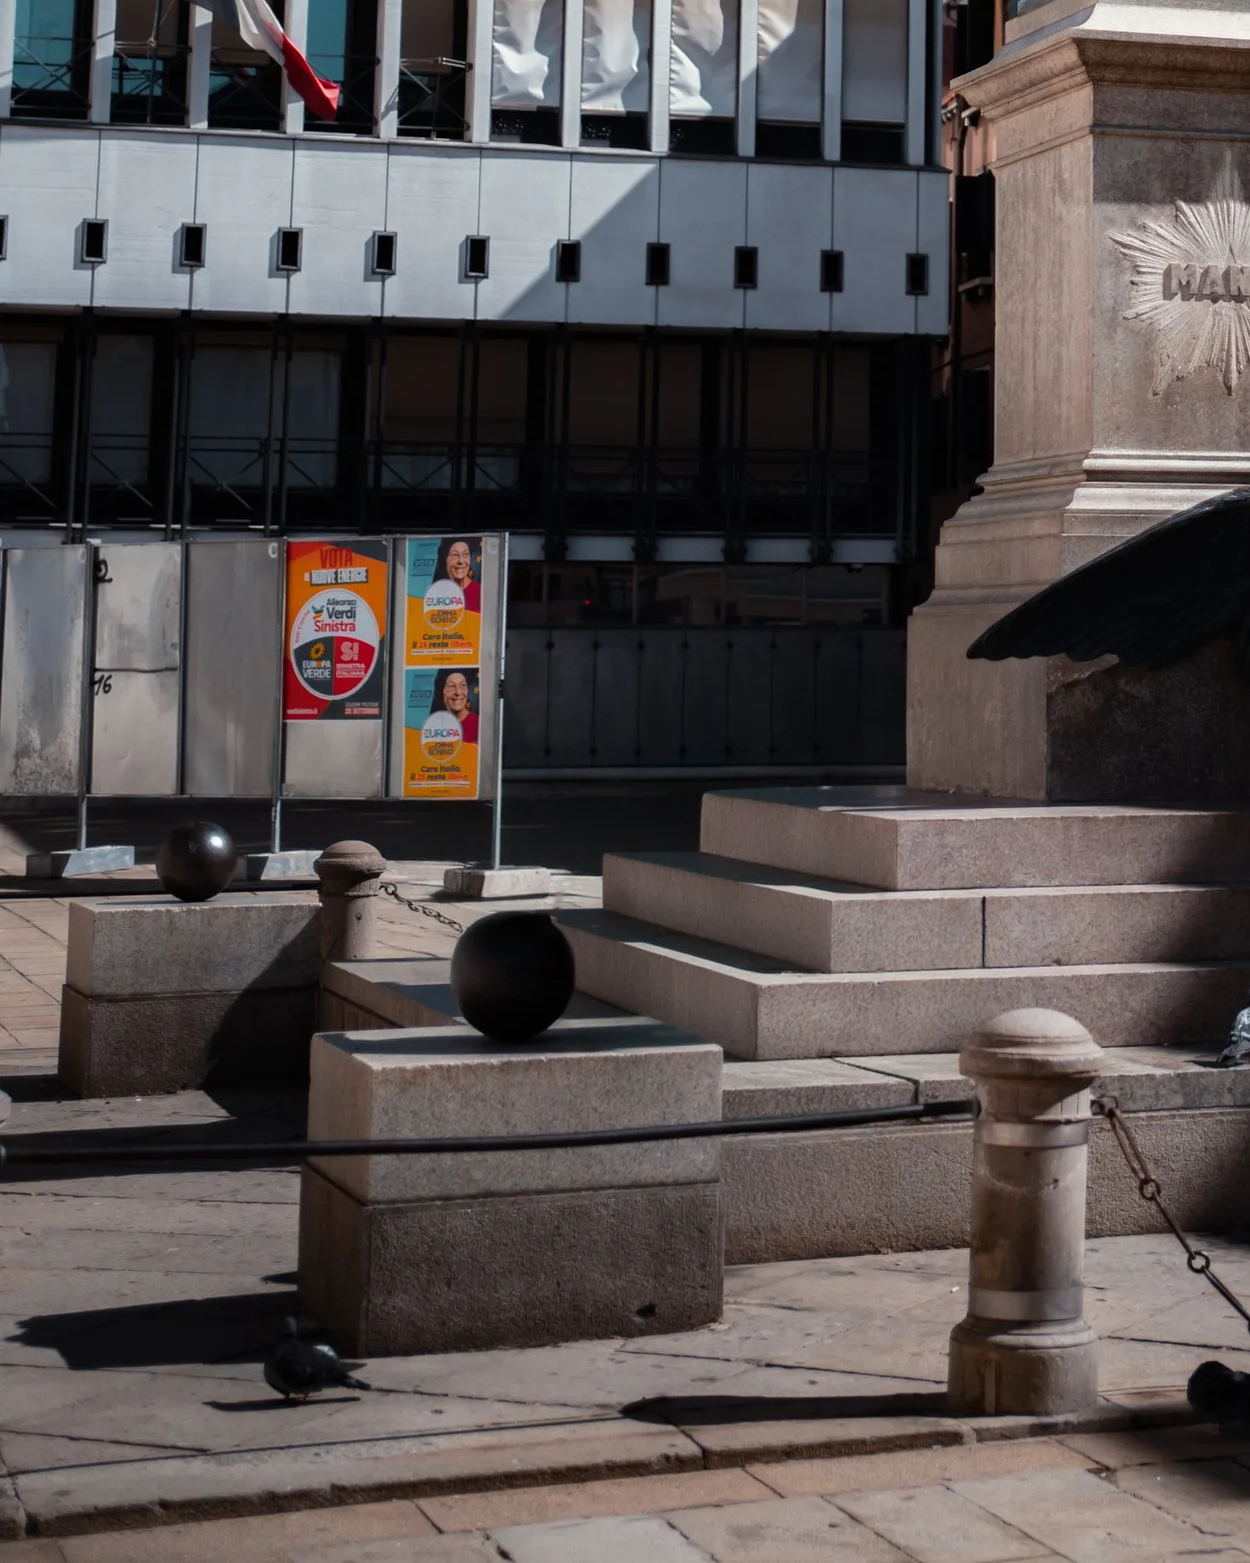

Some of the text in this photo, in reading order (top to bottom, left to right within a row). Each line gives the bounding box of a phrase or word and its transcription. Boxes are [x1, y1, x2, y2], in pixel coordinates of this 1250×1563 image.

[320, 548, 353, 569] VOTA
[311, 570, 337, 584] NUOVE
[338, 567, 368, 583] ENERGIE
[326, 598, 357, 606] Alleanza
[326, 606, 357, 619] Verdi
[314, 619, 356, 633] Sinistra
[302, 660, 332, 669] EUROPA
[303, 669, 332, 678] VERDE
[92, 674, 113, 696] 16
